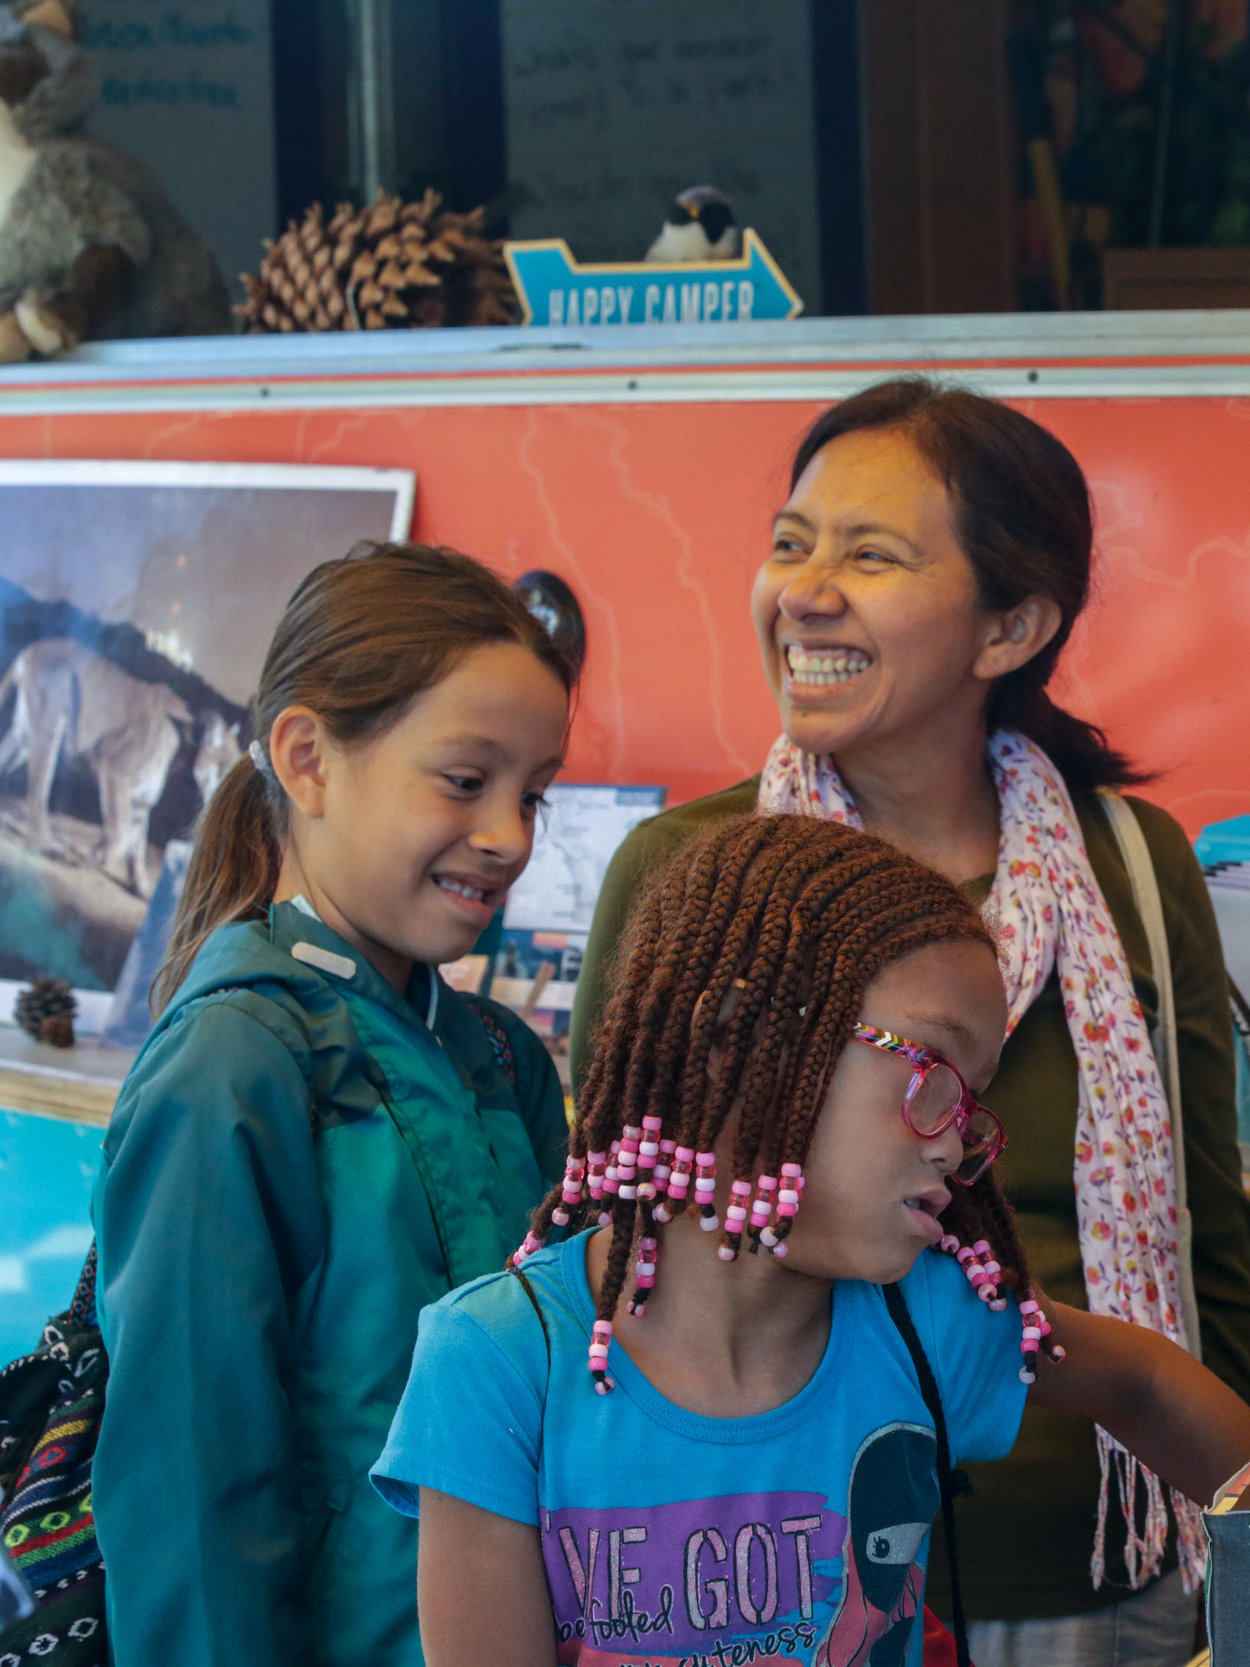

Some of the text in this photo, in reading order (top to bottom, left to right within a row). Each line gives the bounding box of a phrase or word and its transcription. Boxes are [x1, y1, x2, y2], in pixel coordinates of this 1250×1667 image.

[549, 280, 754, 325] HAPPY CAMPER
[683, 1514, 823, 1631] GOT
[589, 1584, 673, 1647] fooled
